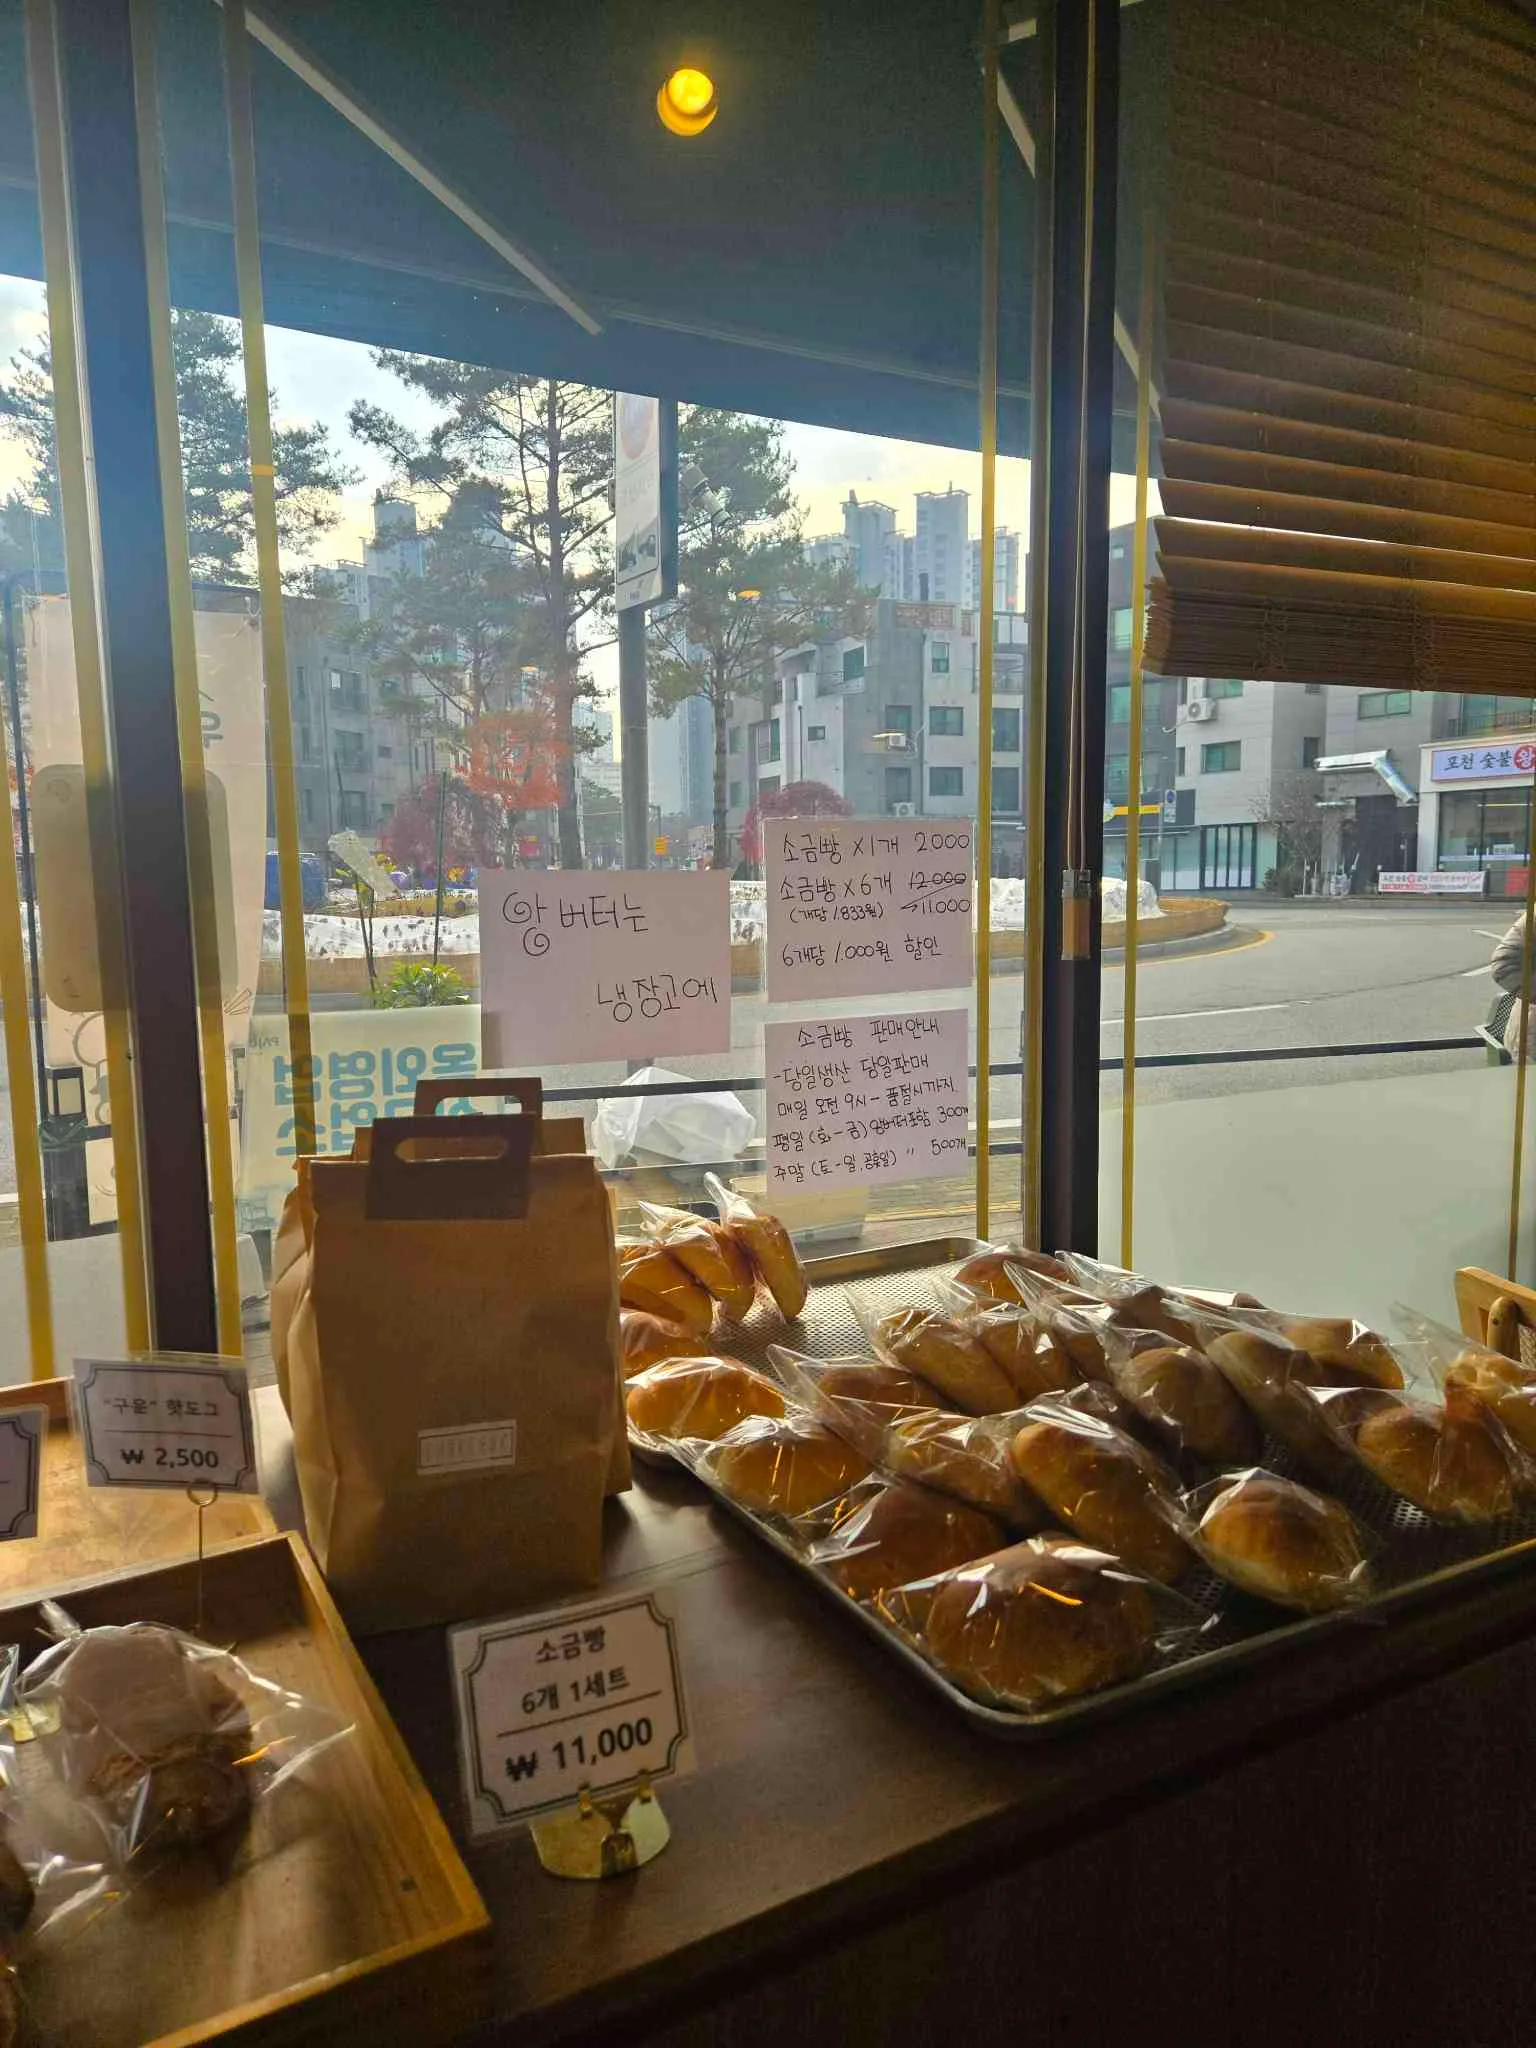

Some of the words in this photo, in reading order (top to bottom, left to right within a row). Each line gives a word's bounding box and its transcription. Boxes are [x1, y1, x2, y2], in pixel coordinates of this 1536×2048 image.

[783, 832, 842, 865] 소금빵
[914, 832, 970, 852] 2000
[559, 893, 648, 932] 버터는
[782, 943, 825, 967] 6개당
[904, 934, 943, 960] 할인
[597, 974, 718, 1022] 냉장고에
[798, 1023, 854, 1048] 소금빵
[777, 1099, 808, 1121] 매일
[815, 1097, 839, 1115] 오전
[774, 1162, 805, 1183] 주말
[167, 1397, 220, 1418] 핫도그
[155, 1447, 219, 1469] 2,500
[535, 1625, 606, 1664] 소금빵
[521, 1682, 560, 1715] 6개
[570, 1666, 630, 1703] 1세트
[552, 1717, 654, 1770] 11,000
